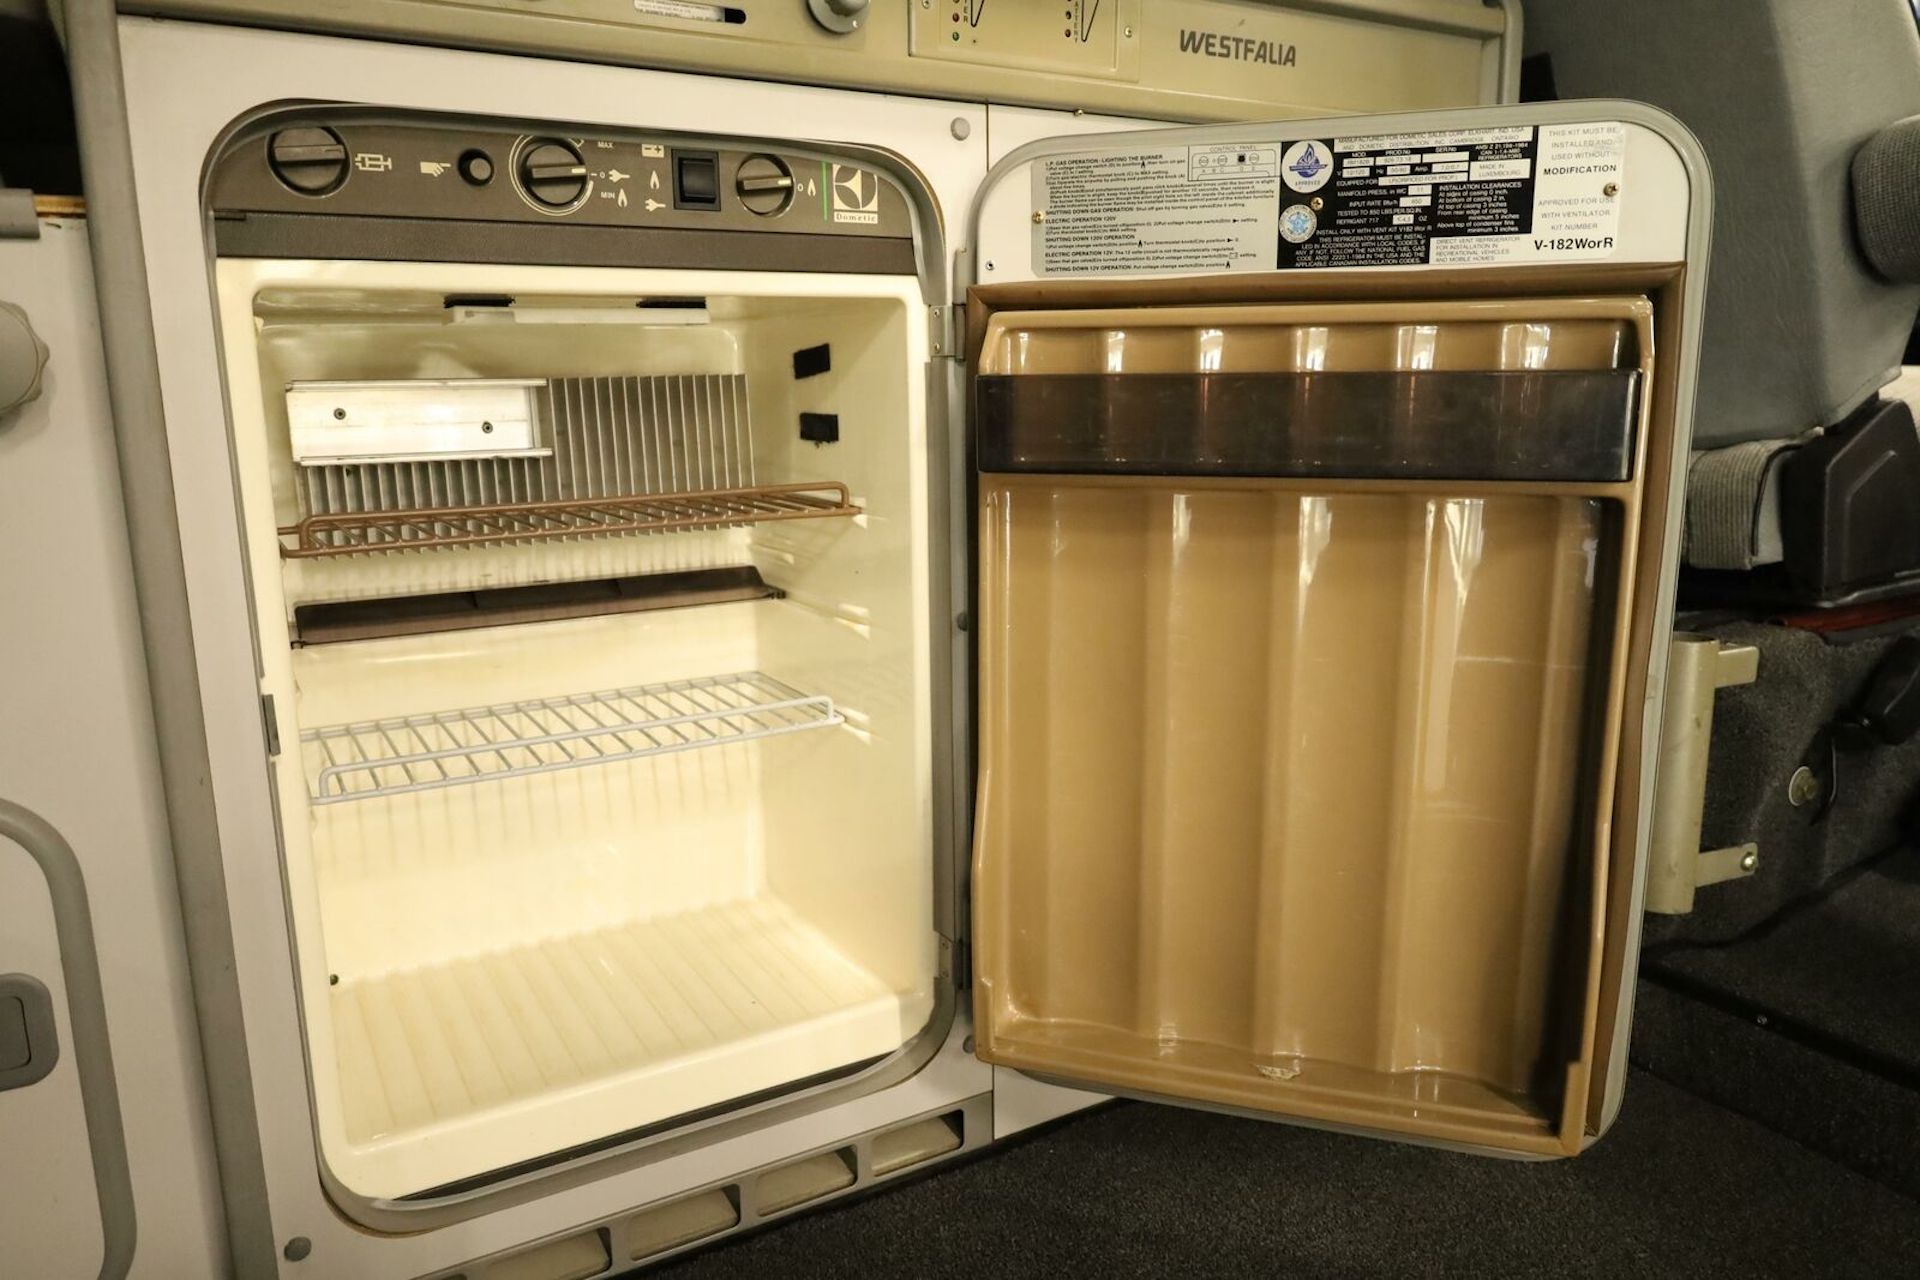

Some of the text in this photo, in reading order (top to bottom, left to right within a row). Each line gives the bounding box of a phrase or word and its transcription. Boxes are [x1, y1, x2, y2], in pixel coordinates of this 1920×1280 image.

[1180, 29, 1296, 67] WESTFALIA
[1552, 140, 1594, 148] INSTALLED
[1575, 151, 1611, 159] WITHOUT
[1543, 164, 1617, 176] MODIFICATION
[1538, 198, 1579, 207] APPROVED
[1563, 210, 1610, 218] VENTILATOR
